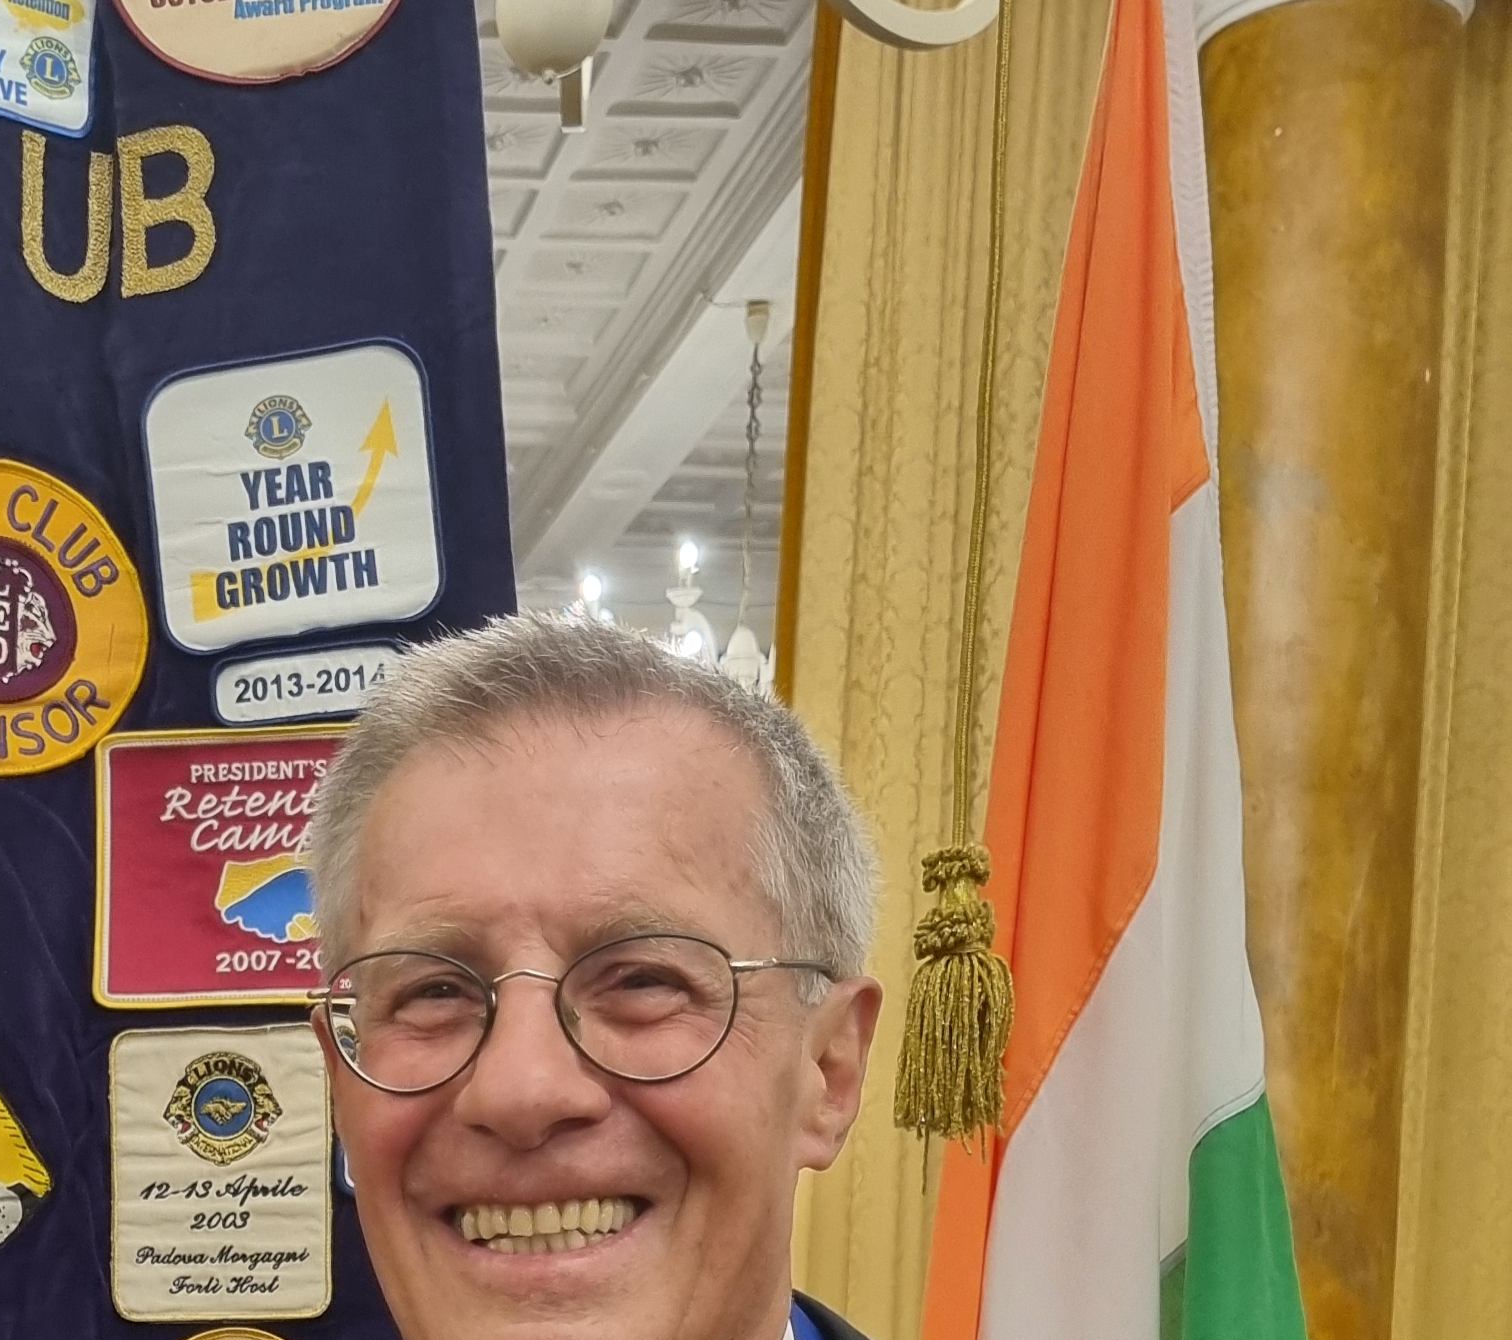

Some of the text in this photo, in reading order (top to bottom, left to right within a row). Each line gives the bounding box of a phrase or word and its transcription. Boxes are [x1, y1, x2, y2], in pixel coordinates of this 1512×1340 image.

[35, 40, 68, 58] LIONS
[257, 399, 296, 413] LIONS
[239, 460, 334, 512] YEAR
[7, 485, 120, 598] CLUB
[227, 505, 356, 563] ROUND
[214, 548, 378, 610] GROWTH
[234, 662, 386, 704] 2013-2014
[190, 759, 327, 783] PRESIDENT'S
[160, 779, 320, 822] Retent
[190, 818, 314, 863] Camp
[215, 949, 323, 973] 2007-20
[192, 1059, 256, 1081] LIONS
[140, 1174, 308, 1207] 12-13 Aprile
[190, 1212, 250, 1230] 2003
[136, 1245, 309, 1270] Padova Morgagni
[226, 1275, 279, 1294] Host
